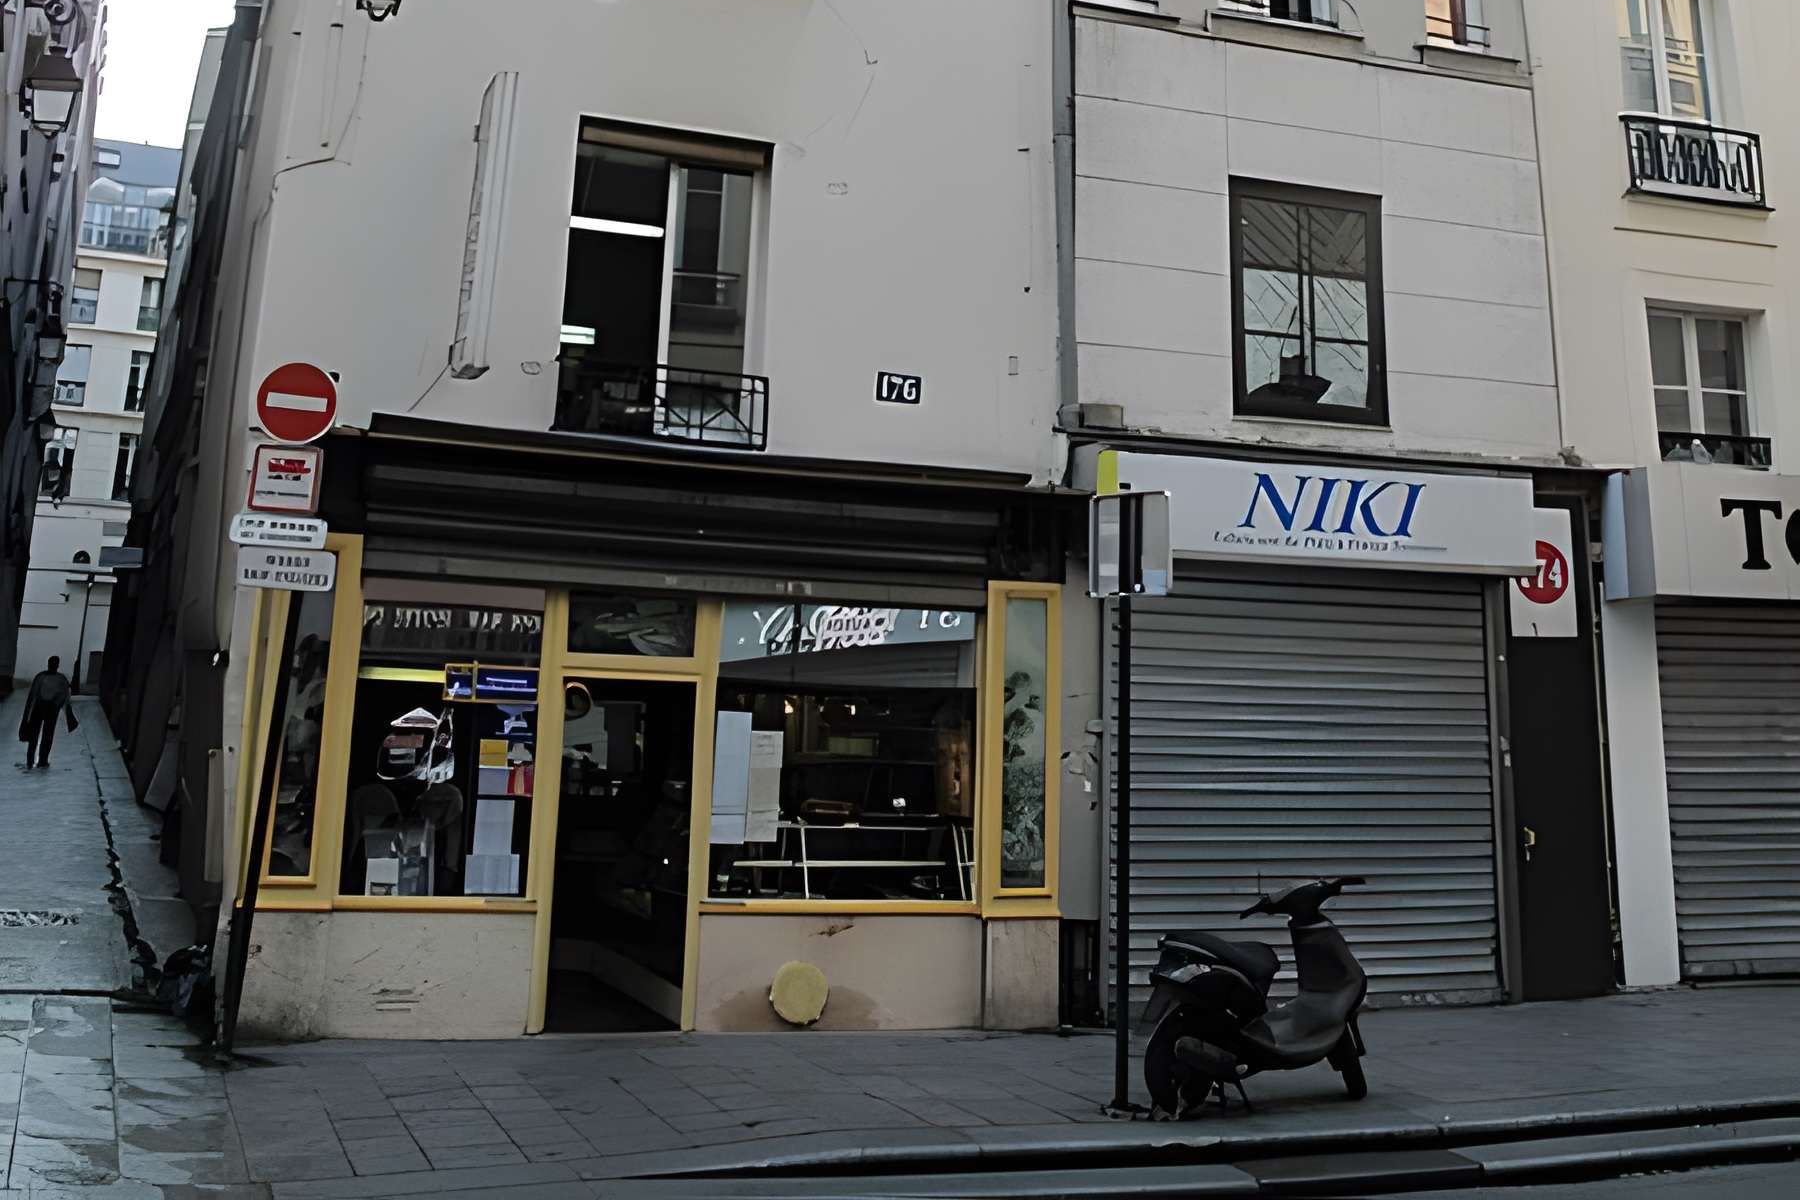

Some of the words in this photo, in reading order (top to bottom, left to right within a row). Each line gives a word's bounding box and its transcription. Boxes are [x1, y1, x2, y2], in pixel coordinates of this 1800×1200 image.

[882, 375, 916, 400] 176
[1238, 472, 1427, 538] NIKI
[1720, 497, 1800, 570] T
